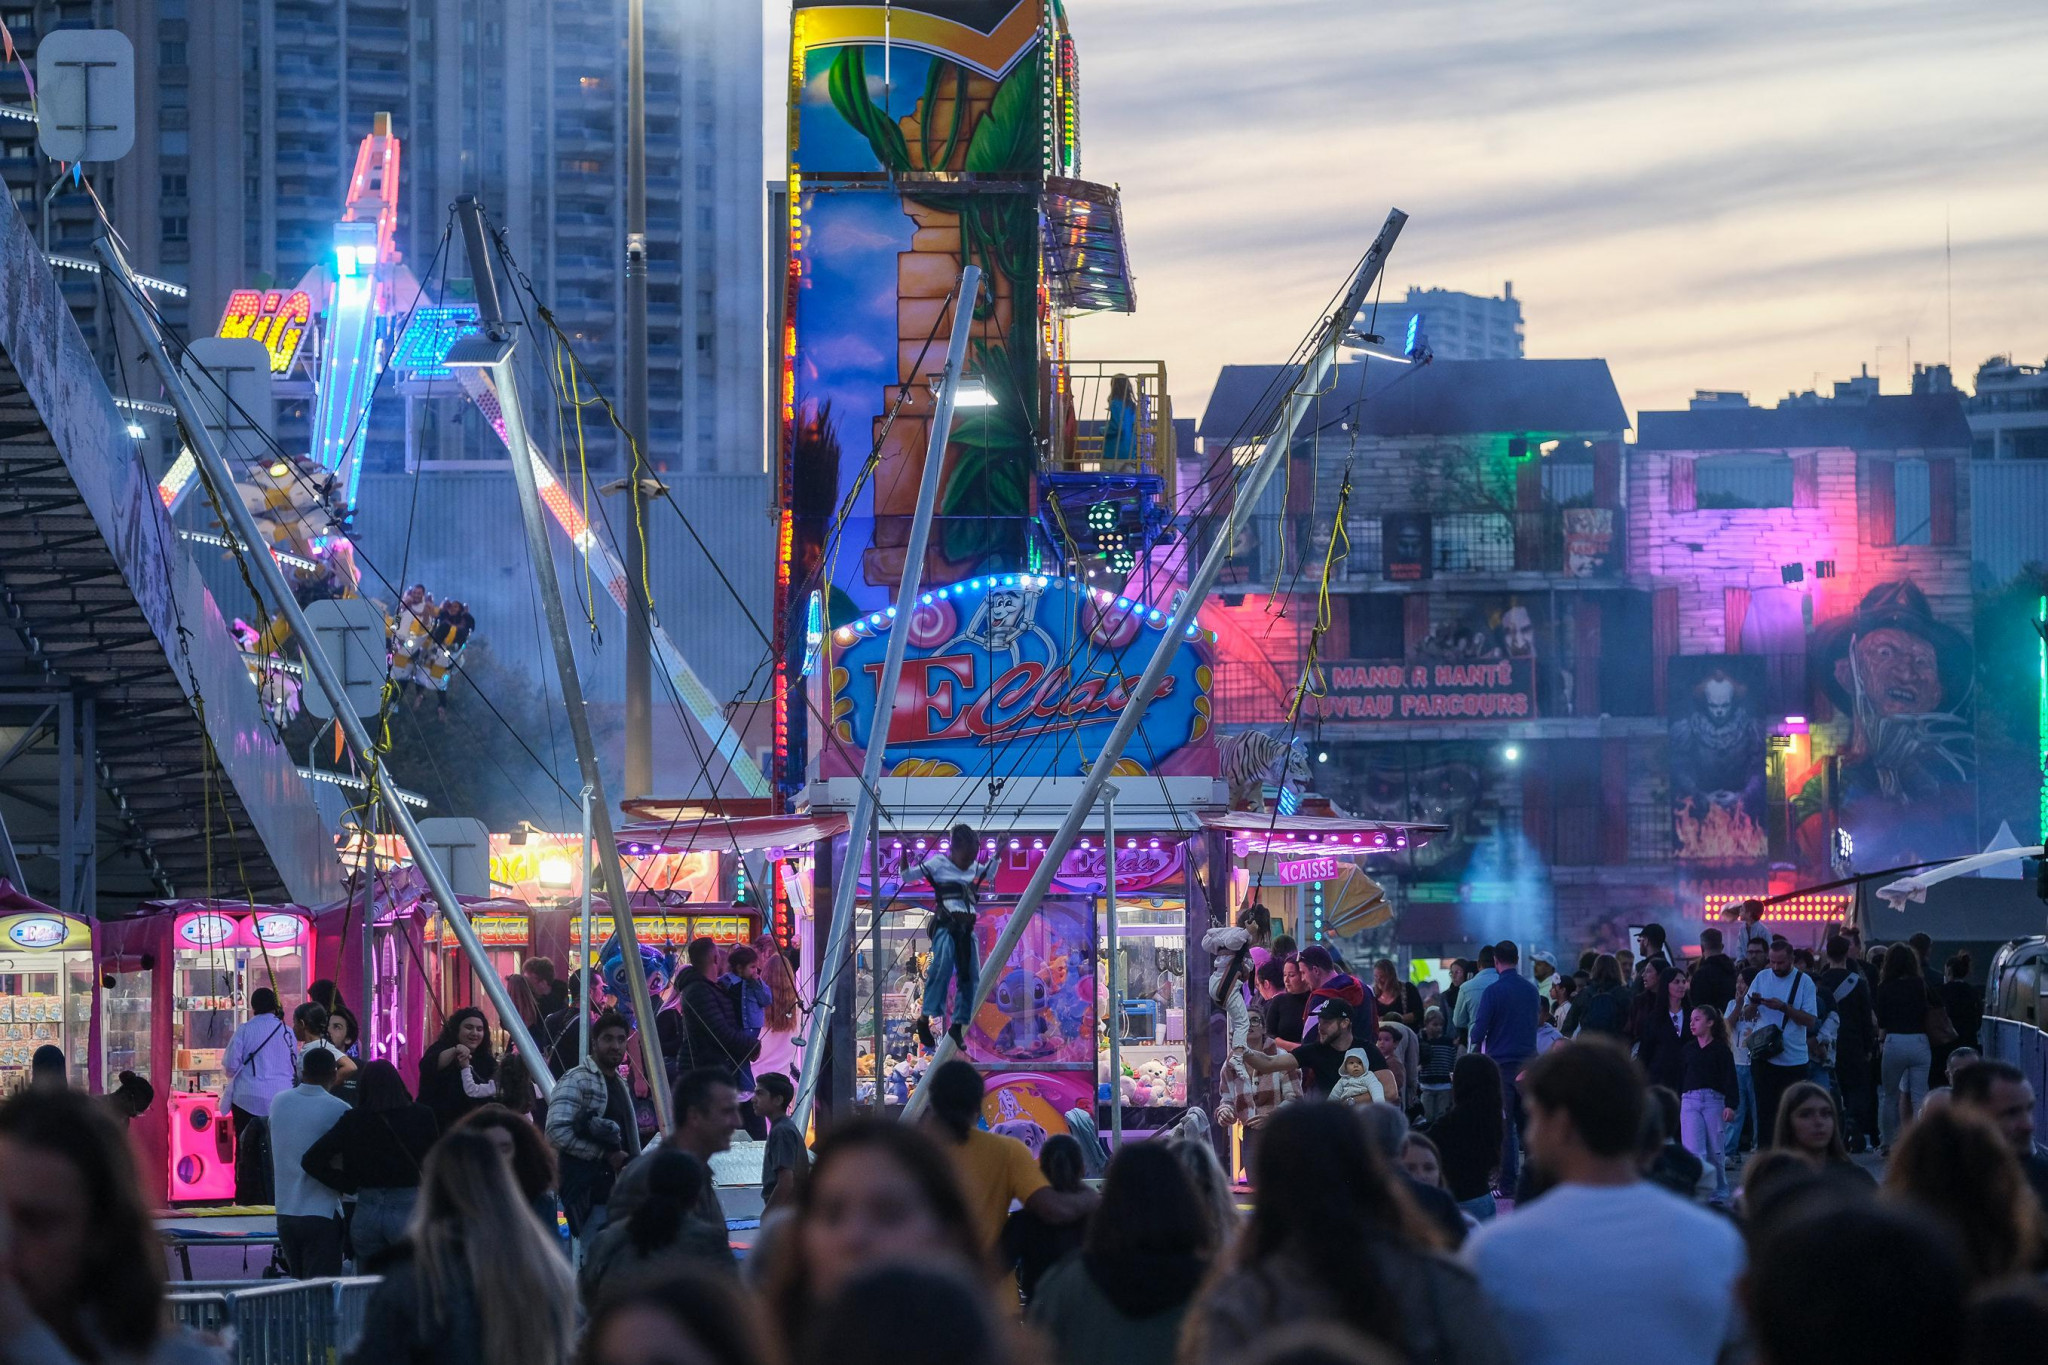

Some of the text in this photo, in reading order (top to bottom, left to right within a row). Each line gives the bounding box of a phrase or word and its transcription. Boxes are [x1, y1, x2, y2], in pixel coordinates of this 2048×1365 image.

[1435, 660, 1512, 689] HANTÉ
[1400, 693, 1529, 718] PARCOURS
[1290, 860, 1335, 881] CAISSE
